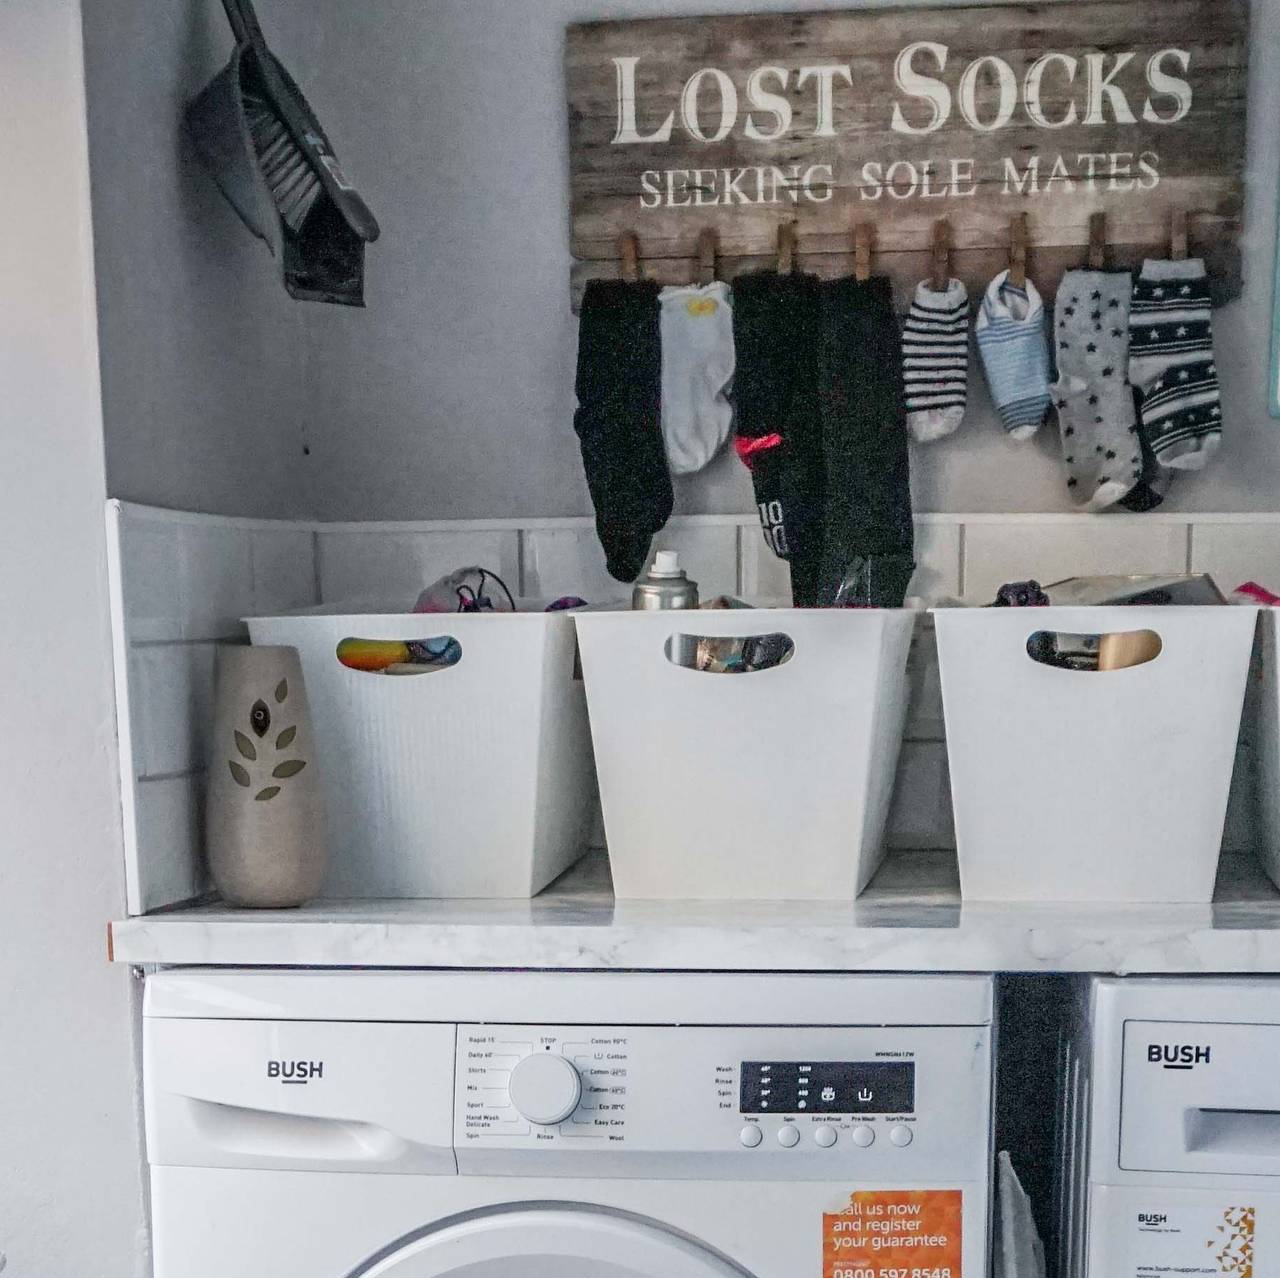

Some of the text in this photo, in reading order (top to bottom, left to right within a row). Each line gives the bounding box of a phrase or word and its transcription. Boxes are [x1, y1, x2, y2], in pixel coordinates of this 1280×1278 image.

[610, 41, 1193, 144] LOST SOCKS
[640, 151, 1160, 209] SEEKING SOLE MATES
[1147, 1044, 1211, 1064] BUSH
[267, 1061, 323, 1078] BUSH
[866, 1206, 883, 1215] us
[888, 1204, 921, 1215] now
[833, 1219, 922, 1234] and register
[1138, 1214, 1167, 1223] BUSH
[833, 1235, 947, 1251] your guarantee
